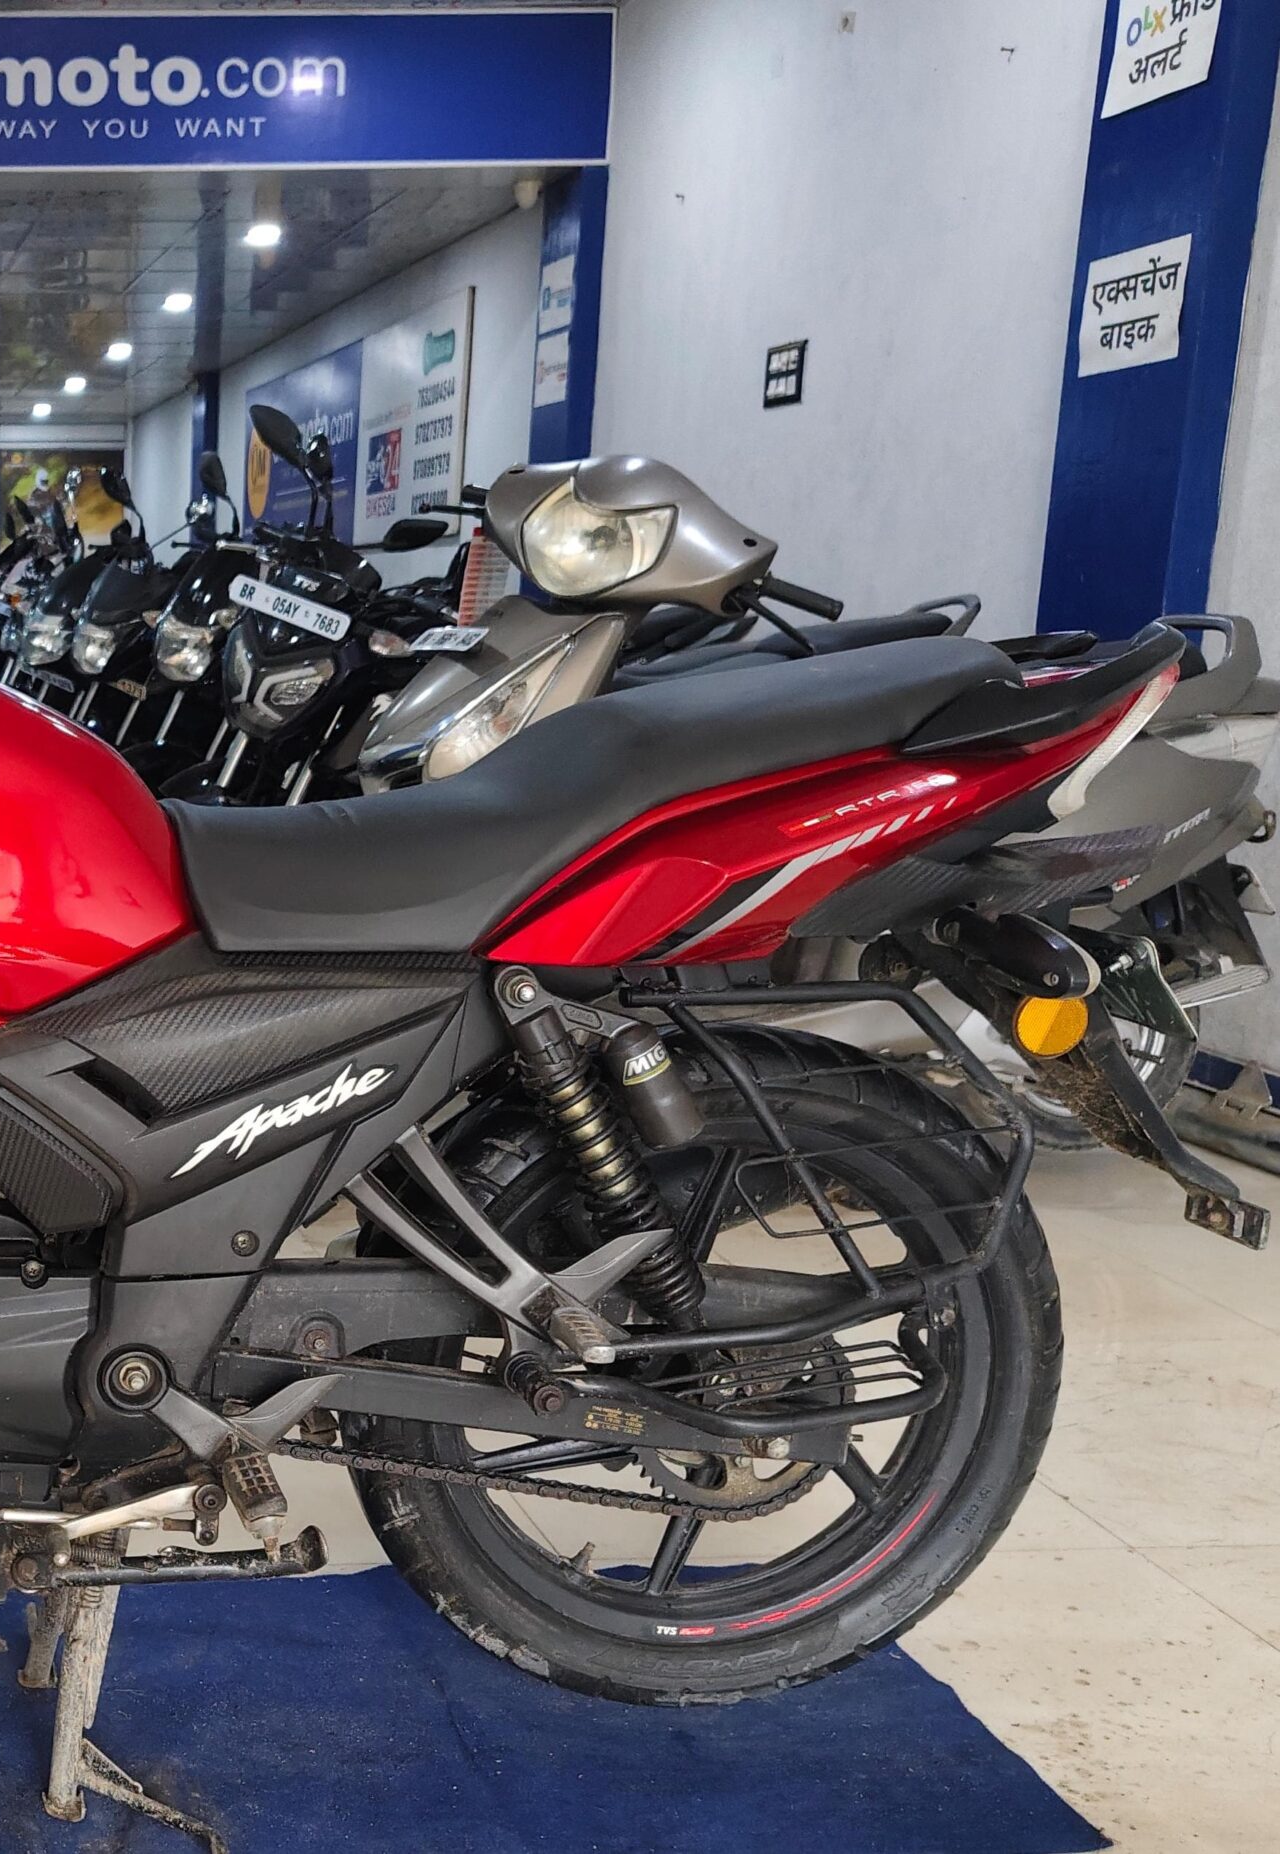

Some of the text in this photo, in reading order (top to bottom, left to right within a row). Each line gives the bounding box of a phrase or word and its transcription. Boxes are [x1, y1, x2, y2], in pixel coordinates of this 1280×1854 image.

[1126, 5, 1168, 47] OLX
[1129, 28, 1188, 84] अलर्ट
[82, 118, 149, 139] YOU
[175, 116, 267, 139] WANT
[1092, 256, 1182, 316] एक्सचेंज
[1100, 313, 1160, 350] बाइक
[240, 583, 341, 636] BR 05AY 7683
[834, 788, 901, 817] RTR
[627, 1045, 666, 1077] MIG
[170, 1063, 395, 1179] Apache
[656, 1626, 677, 1636] TVS
